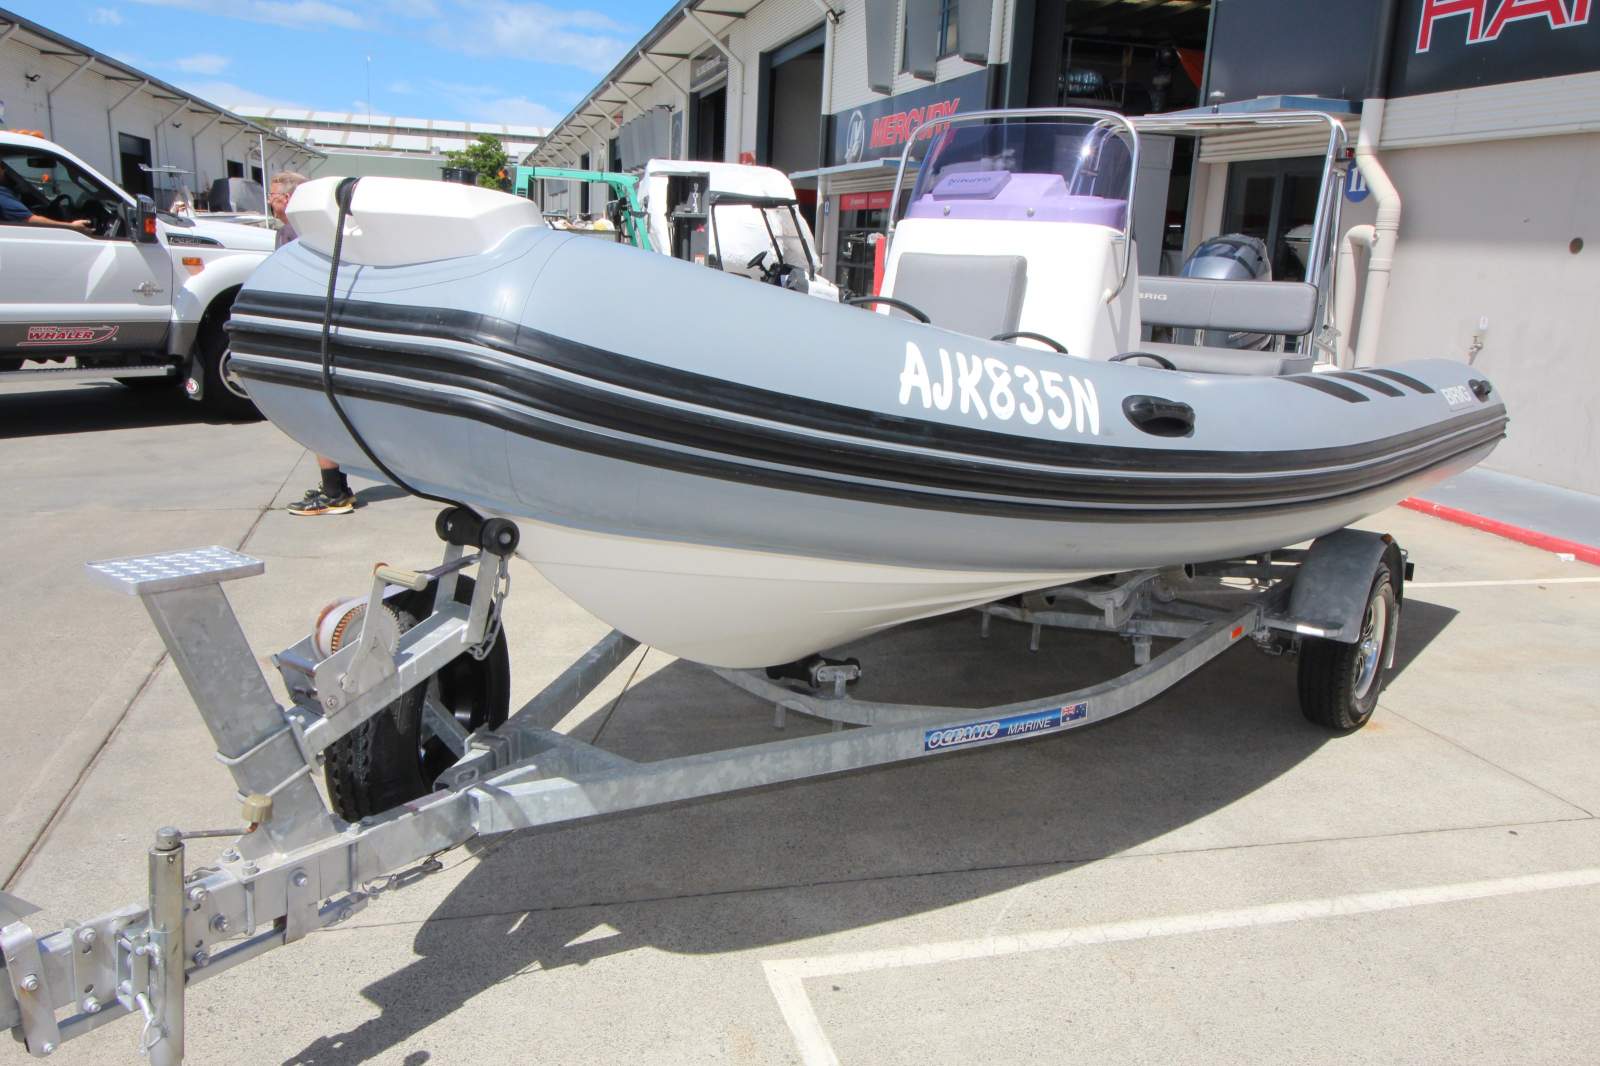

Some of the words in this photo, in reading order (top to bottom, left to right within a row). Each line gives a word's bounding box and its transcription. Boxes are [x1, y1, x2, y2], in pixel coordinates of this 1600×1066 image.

[869, 98, 960, 149] MERCURY
[28, 331, 94, 340] WHALER
[899, 341, 1100, 436] AJK835N
[928, 721, 1000, 749] OCEANIC
[1007, 716, 1051, 736] MARINE
